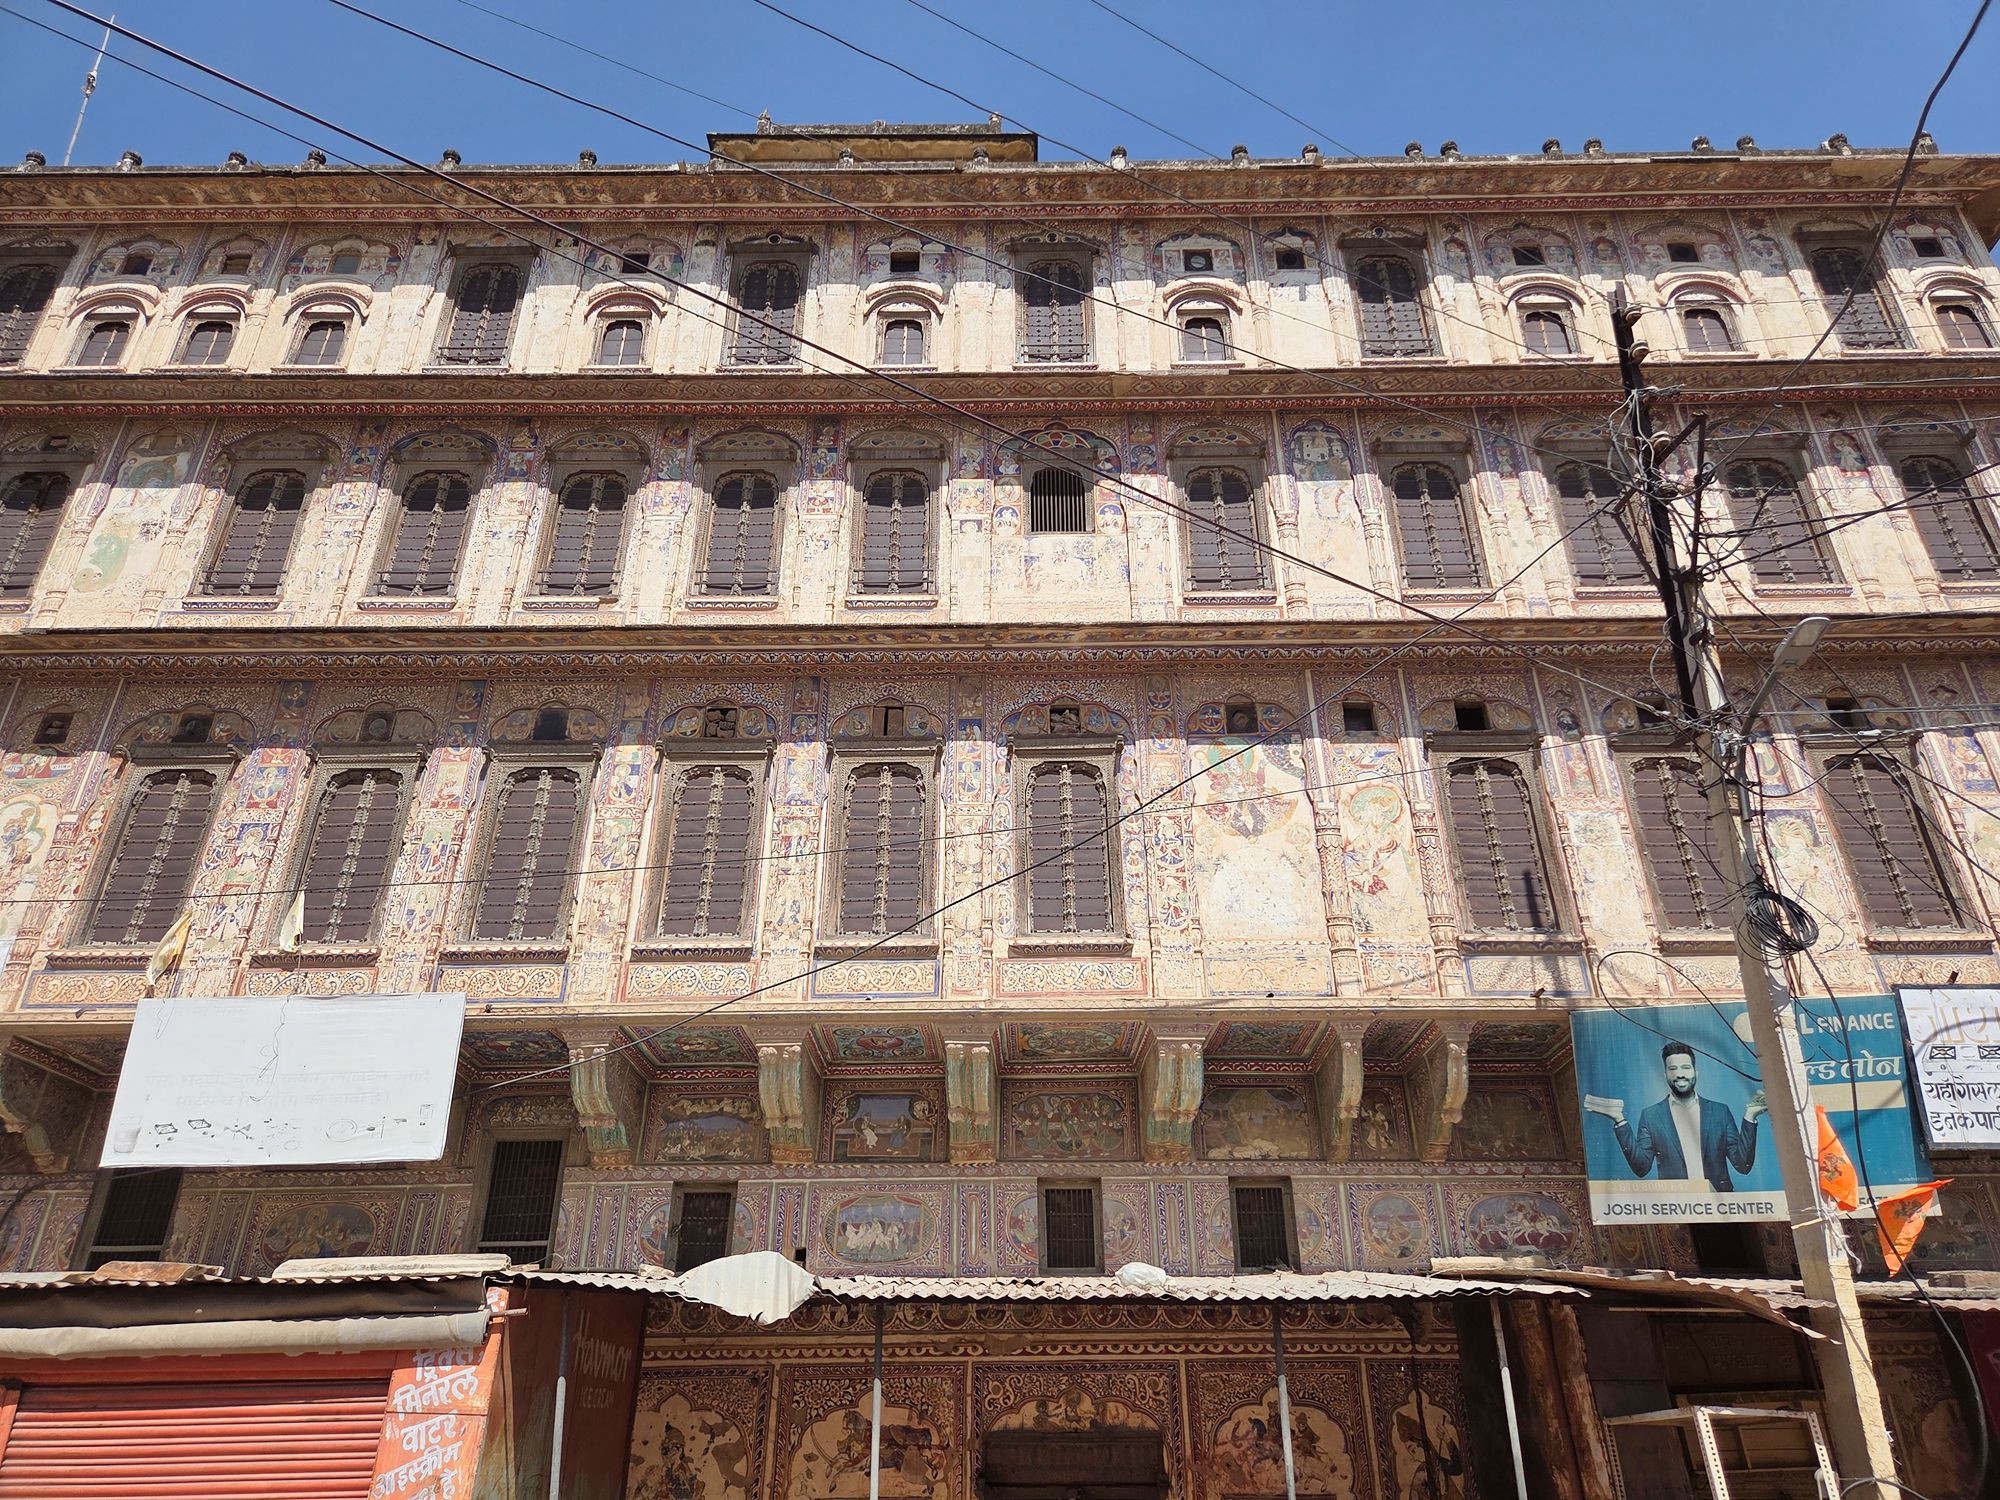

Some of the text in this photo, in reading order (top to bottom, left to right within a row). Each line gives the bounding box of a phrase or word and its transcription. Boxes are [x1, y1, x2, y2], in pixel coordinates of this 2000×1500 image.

[1817, 1012, 1895, 1034] FINANCE
[1603, 1201, 1775, 1216] JOSHI SERVICE CENTER
[392, 1366, 479, 1420] मिनरल
